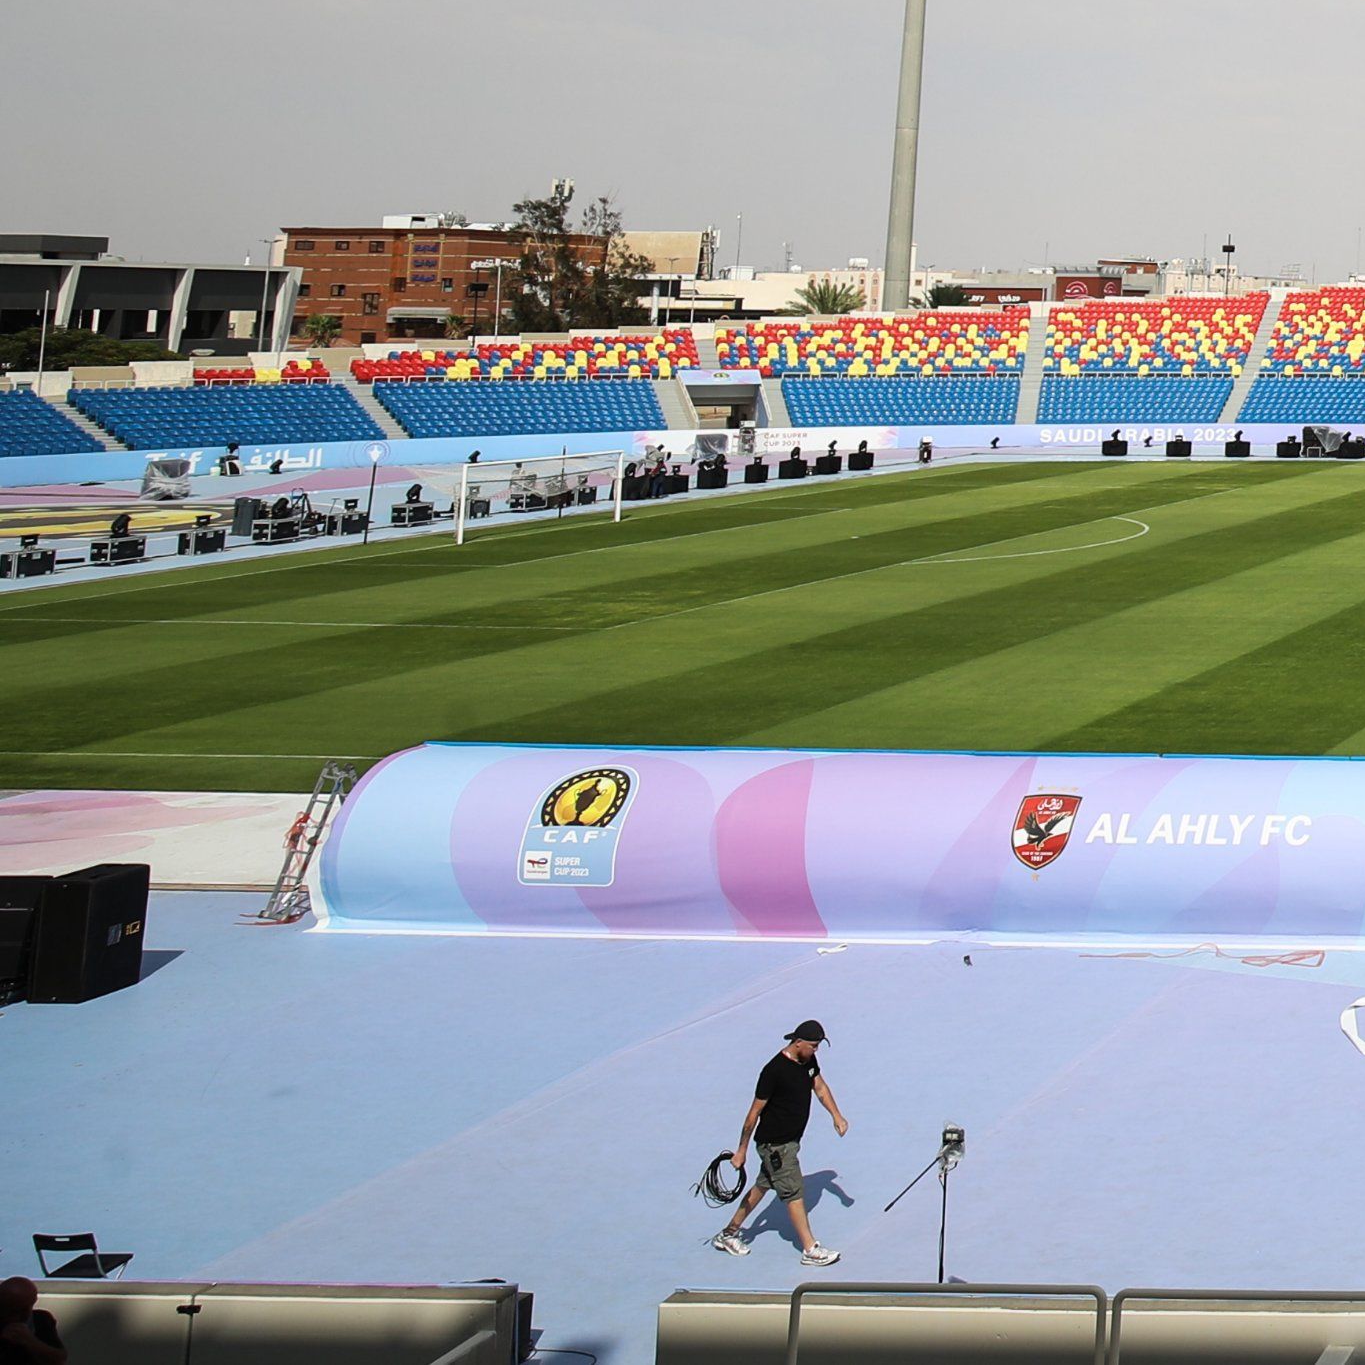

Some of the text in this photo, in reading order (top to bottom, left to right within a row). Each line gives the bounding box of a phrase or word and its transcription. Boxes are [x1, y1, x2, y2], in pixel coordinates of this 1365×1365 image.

[1040, 428, 1102, 443] SAUDI
[1193, 428, 1236, 442] 2023
[1085, 813, 1312, 846] AL AHLY FC
[543, 830, 599, 843] CAF
[554, 857, 580, 866] SUPER
[554, 867, 569, 876] CUP
[570, 868, 589, 877] 2023
